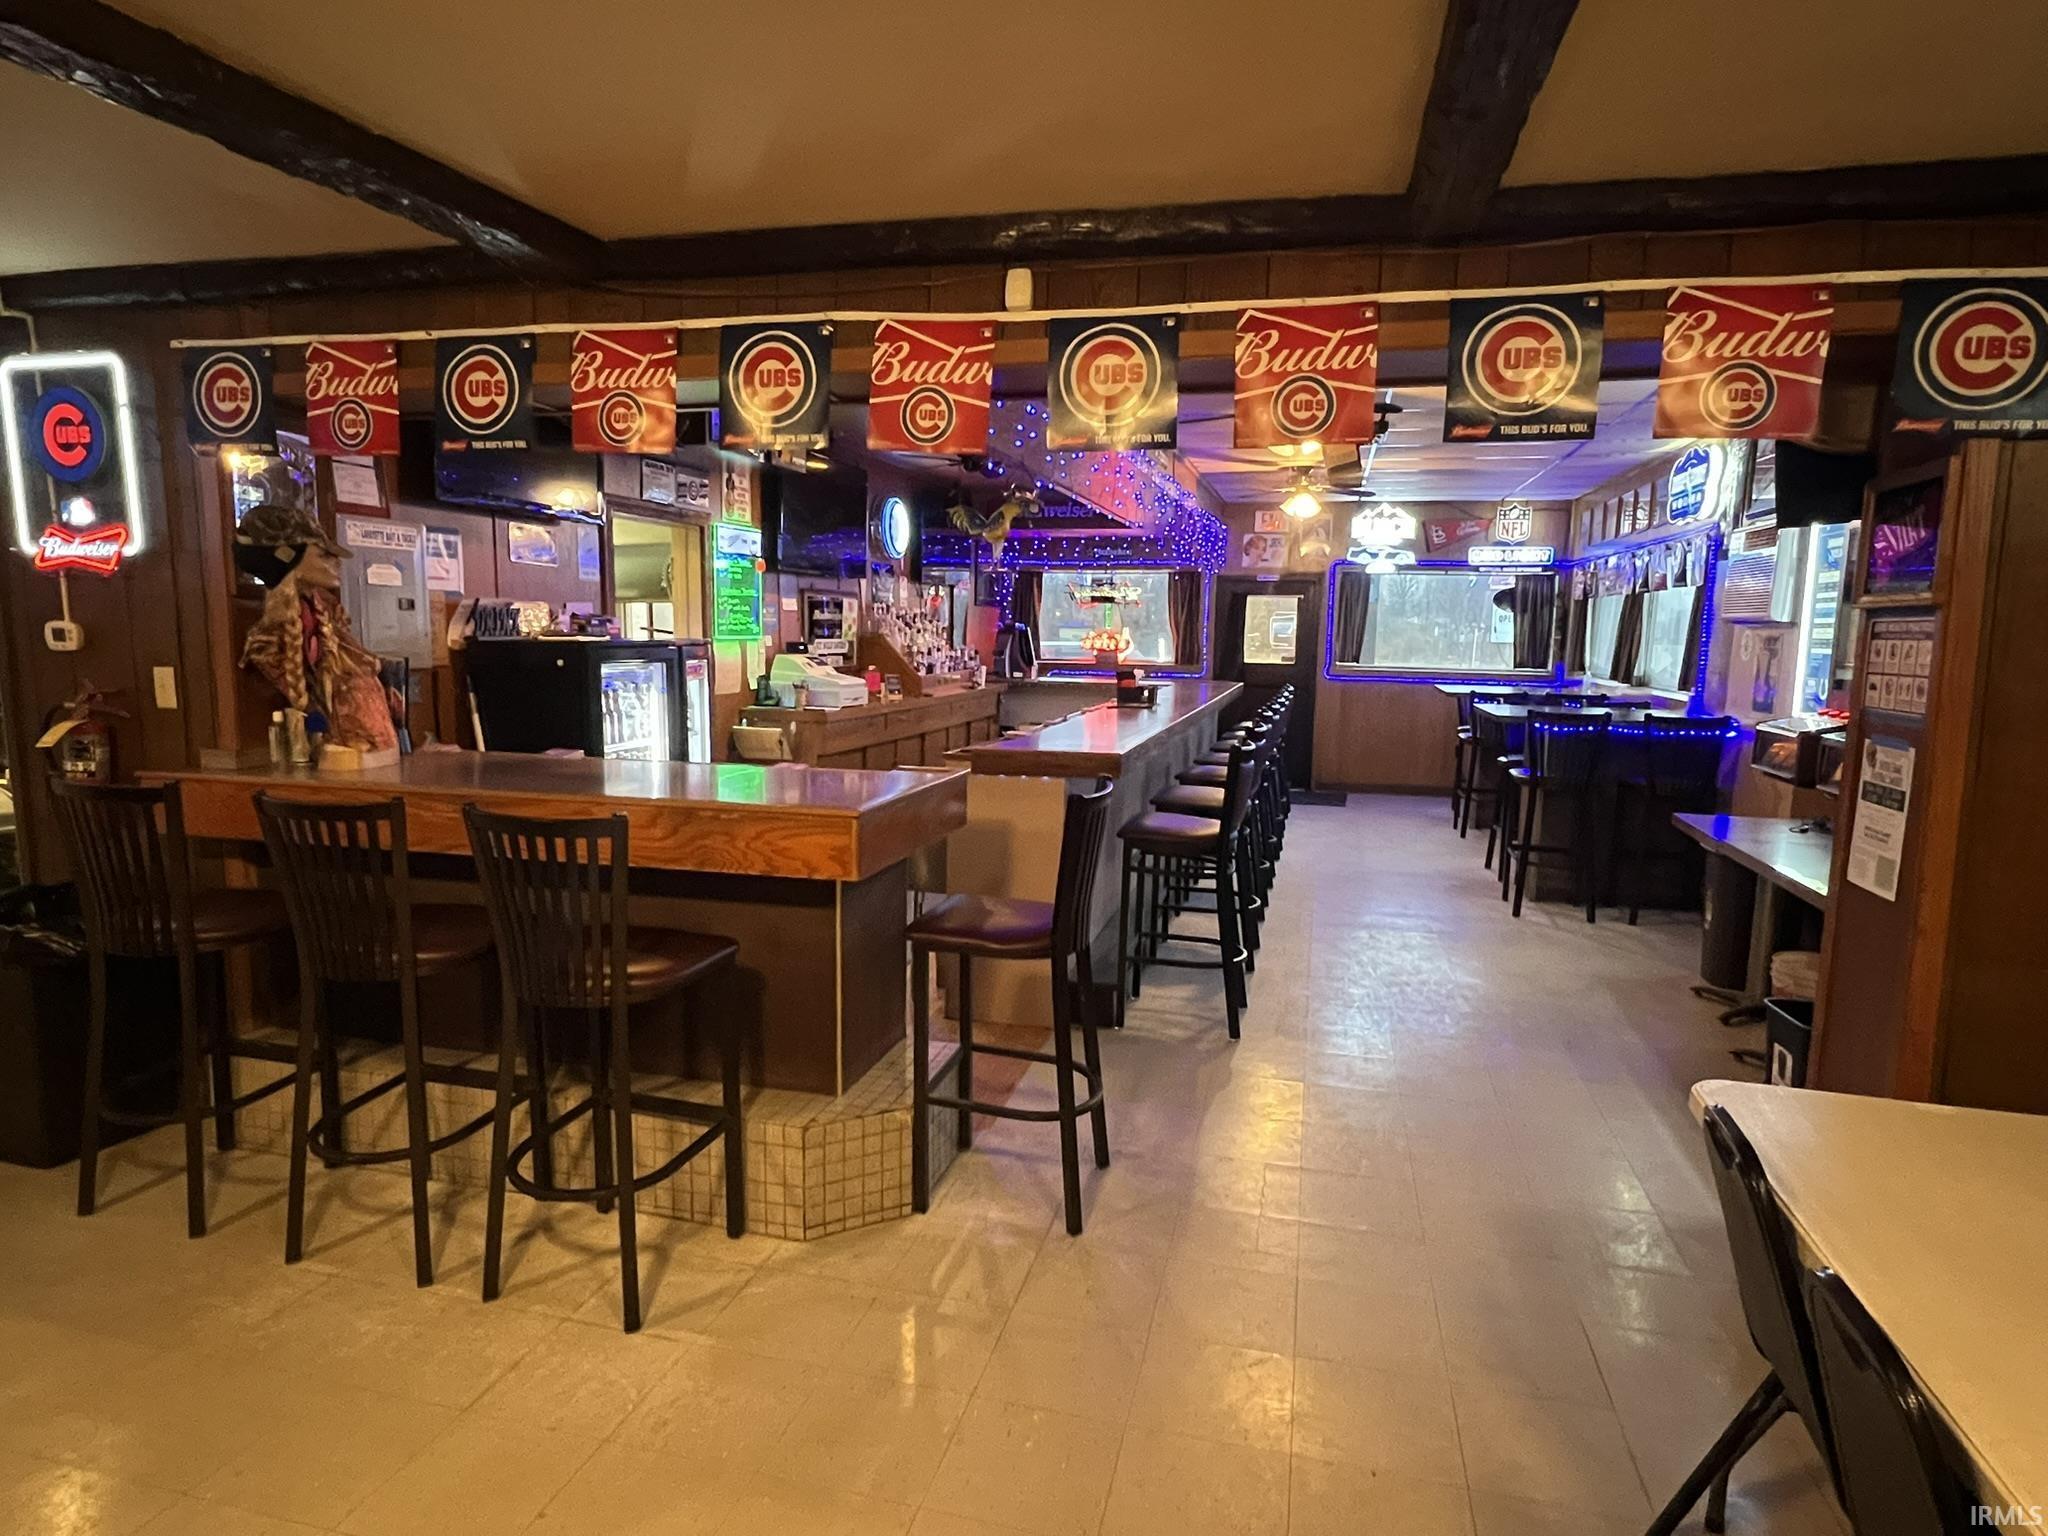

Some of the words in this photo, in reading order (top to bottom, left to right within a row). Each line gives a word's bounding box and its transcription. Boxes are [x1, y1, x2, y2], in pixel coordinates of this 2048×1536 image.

[1481, 321, 1562, 398] CUBS
[1936, 307, 2031, 390] CUBS
[204, 366, 249, 423] CUBS
[455, 360, 505, 420] CUBS
[743, 347, 801, 413] CUBS
[1076, 340, 1143, 412] CUBS
[1718, 371, 1764, 418] CUBS
[337, 405, 365, 441] CUBS
[606, 401, 637, 437] CUBS
[909, 394, 946, 436] CUBS
[1280, 381, 1325, 430] CUBS
[1500, 425, 1520, 434] THIS
[1521, 424, 1548, 434] BUD'S
[1549, 424, 1567, 434] FOR
[1569, 423, 1590, 433] YOU.
[1953, 420, 1976, 430] THIS
[1978, 420, 2010, 430] BUD'S
[2012, 420, 2034, 430] FOR
[2035, 420, 2048, 430] YO
[43, 403, 92, 466] CUBS
[40, 536, 118, 557] Budweiser
[1501, 520, 1526, 538] NFL
